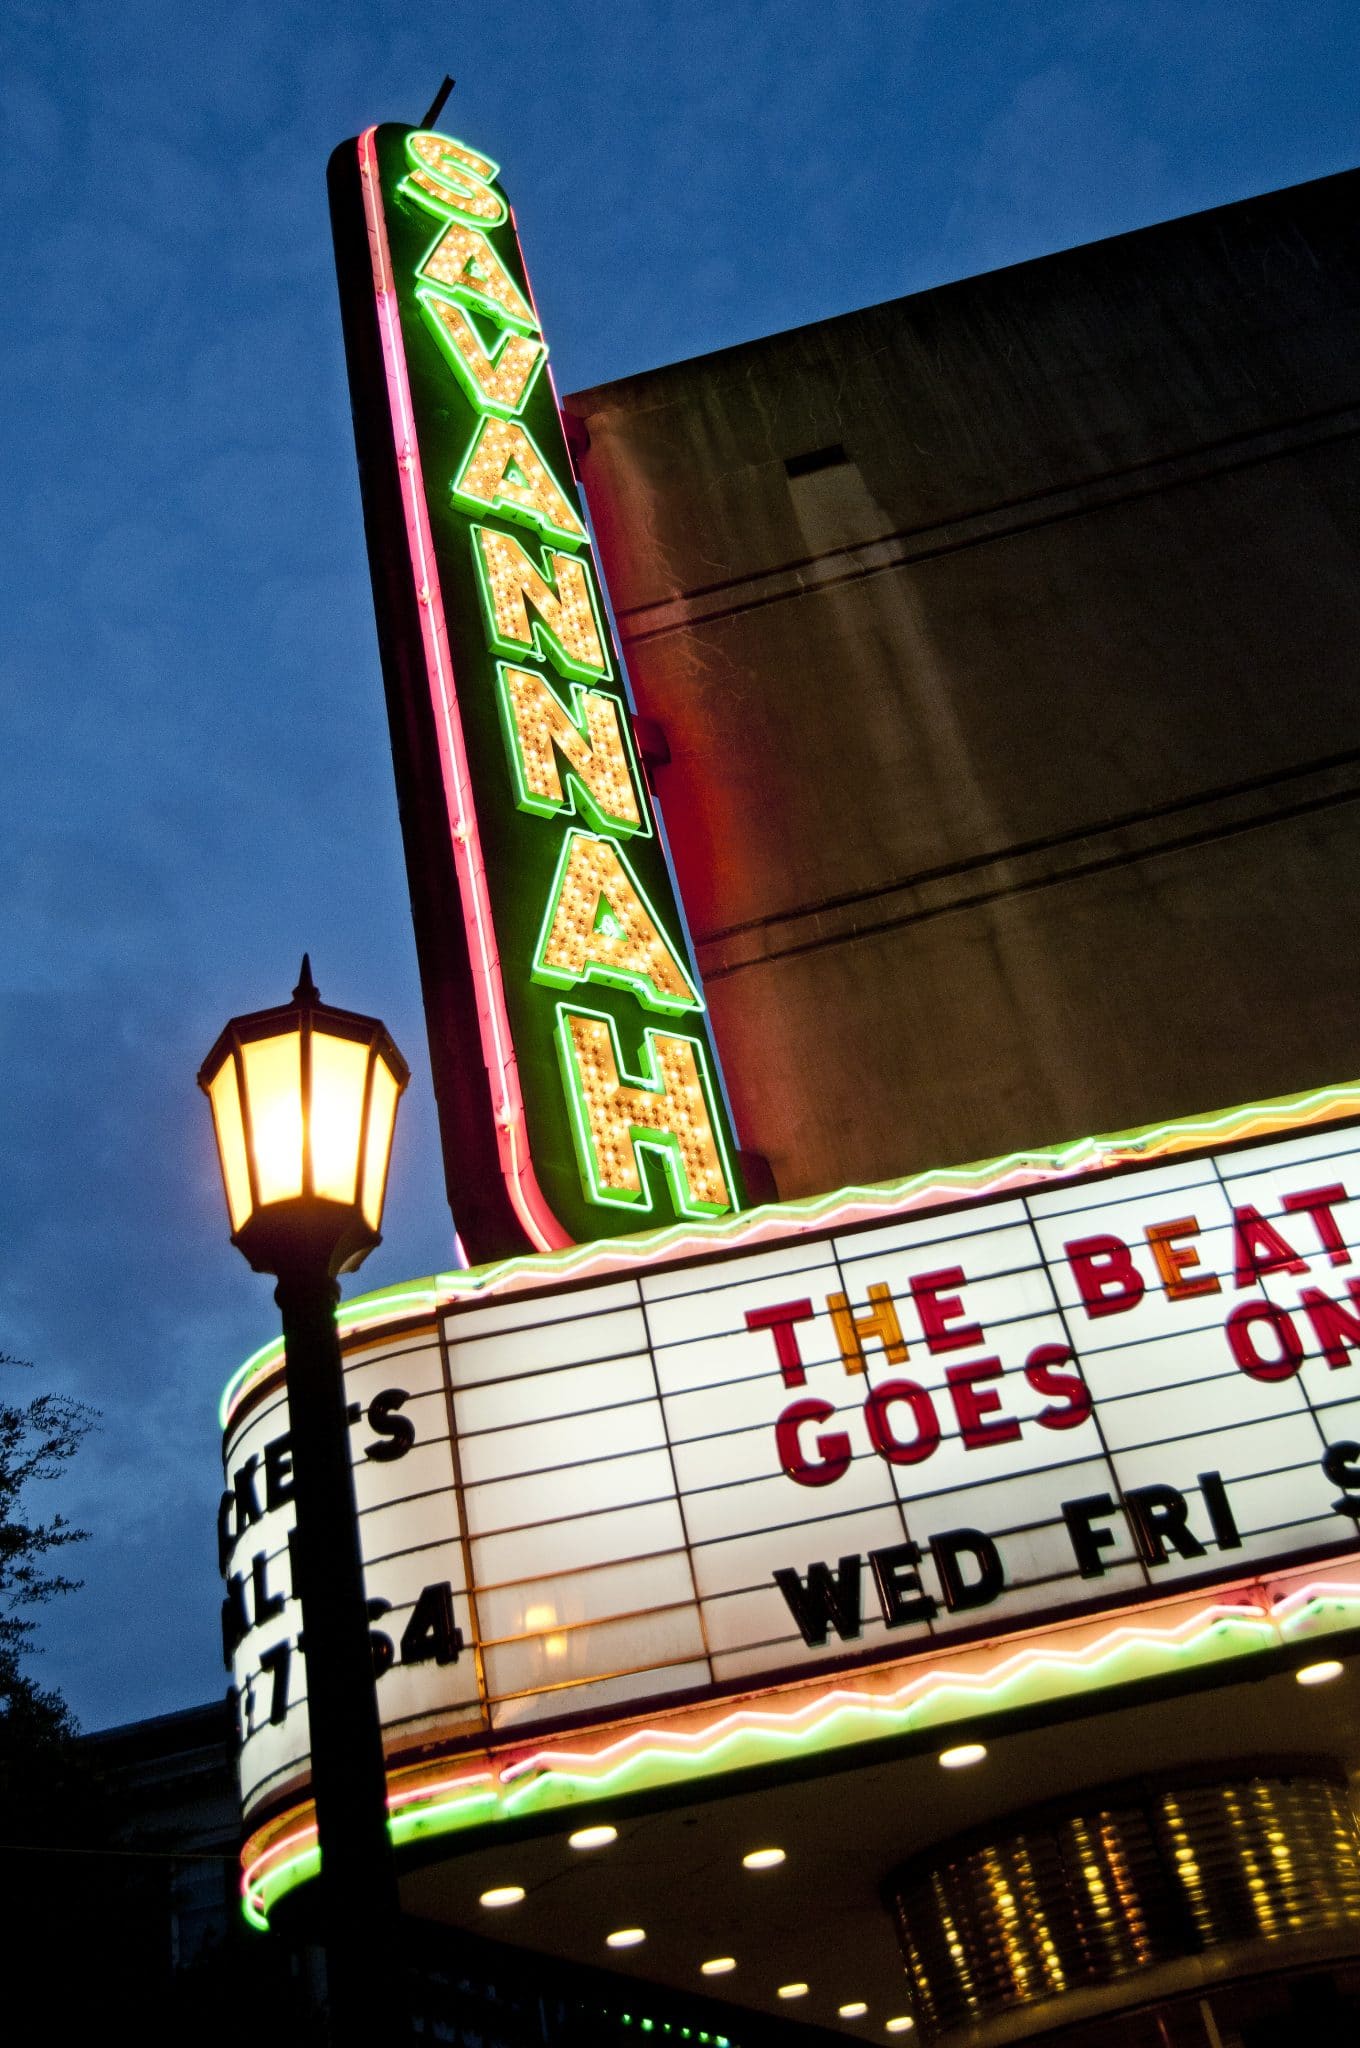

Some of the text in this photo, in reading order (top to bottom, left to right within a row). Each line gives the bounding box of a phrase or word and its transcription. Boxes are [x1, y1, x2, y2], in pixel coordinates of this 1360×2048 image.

[397, 130, 740, 1219] SAVANNAH
[744, 1182, 1352, 1389] THE BEAT
[775, 1277, 1360, 1487] GOES ON
[772, 1527, 1003, 1647] WED
[1061, 1470, 1242, 1578] FRI
